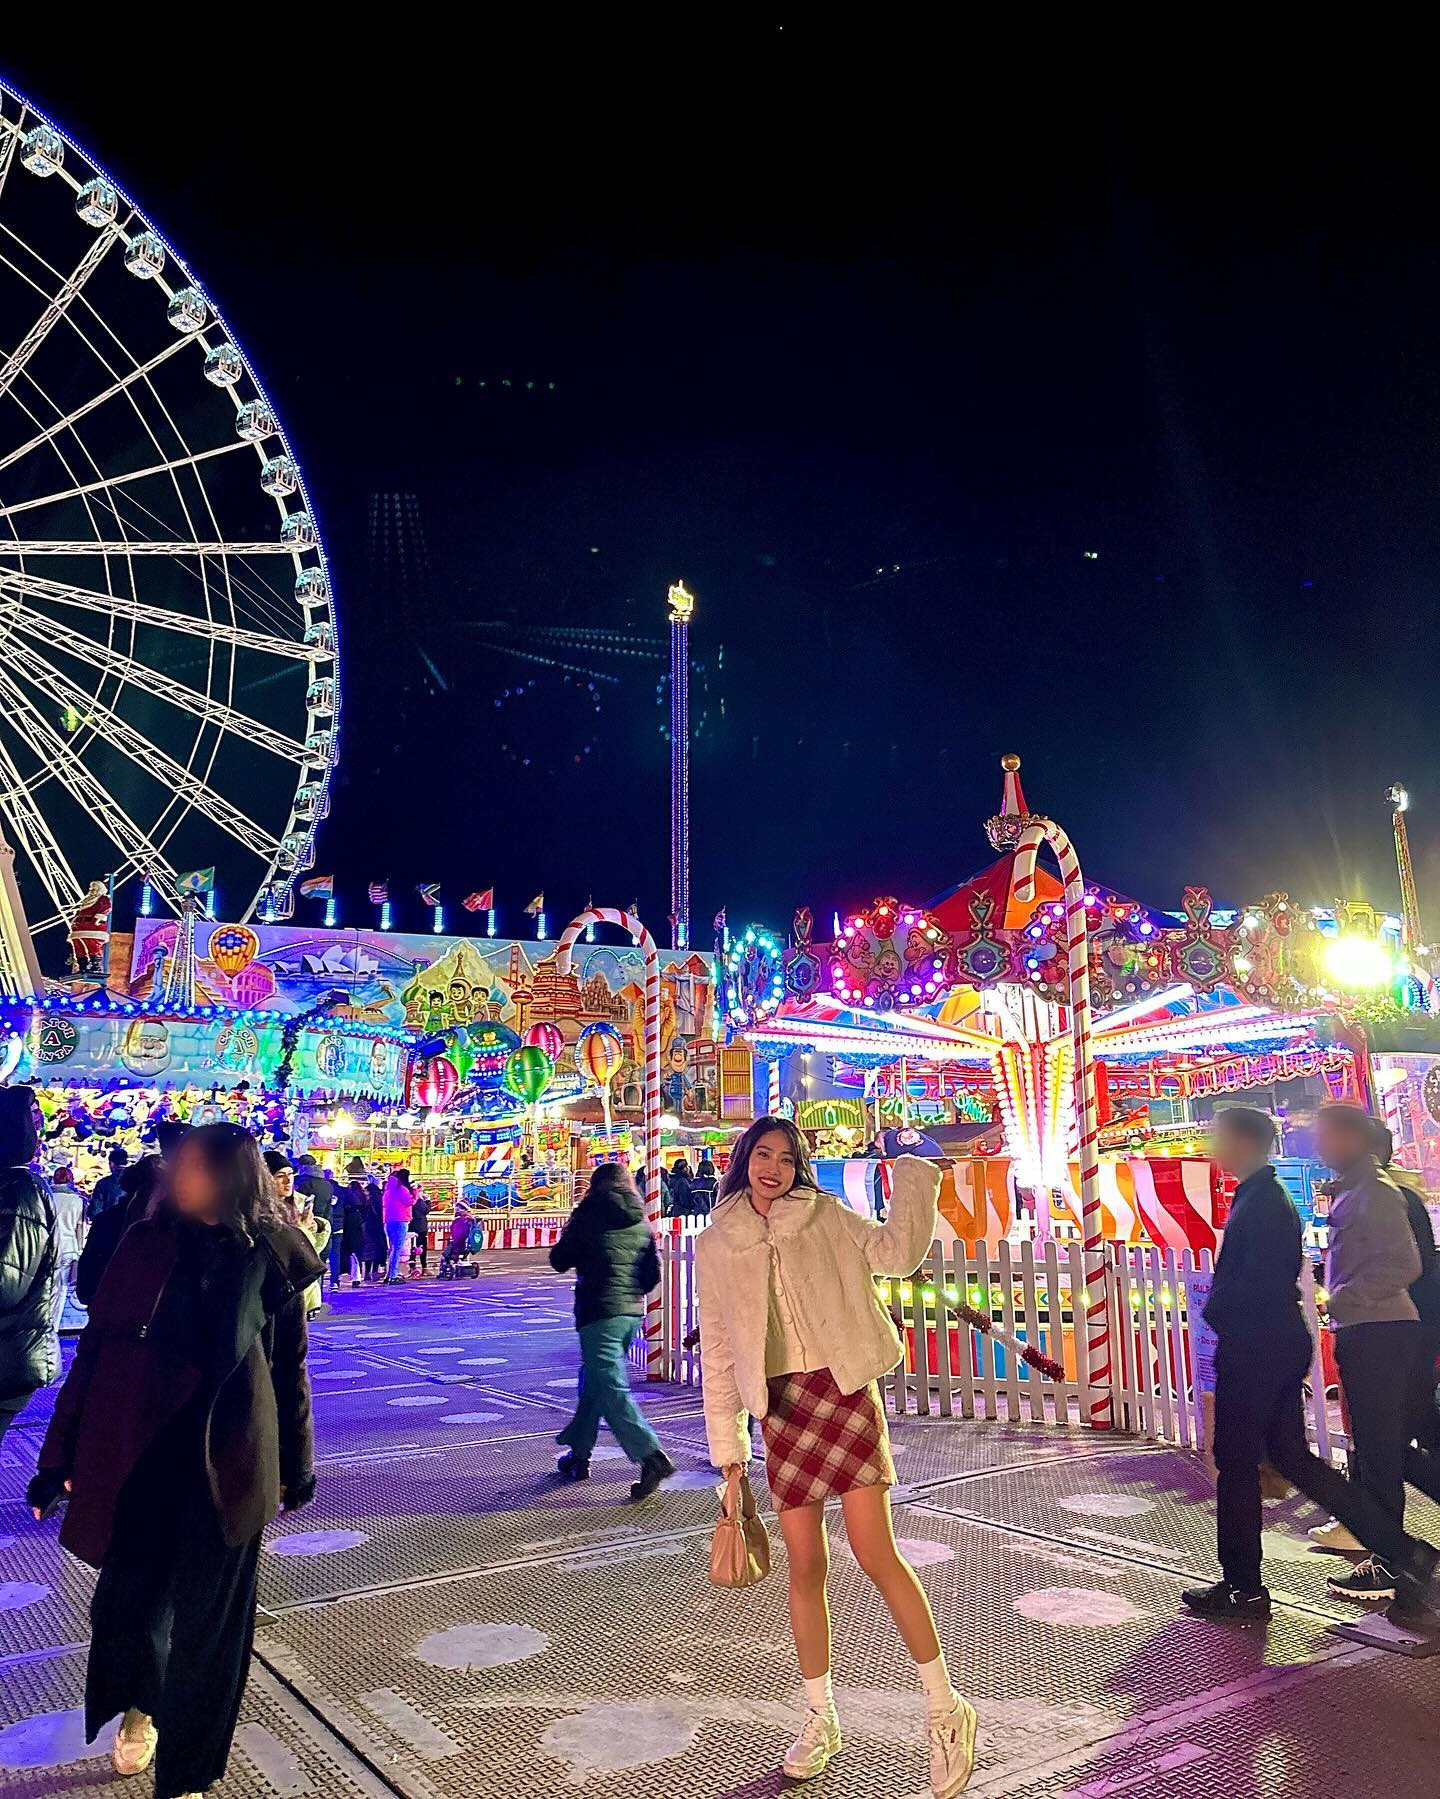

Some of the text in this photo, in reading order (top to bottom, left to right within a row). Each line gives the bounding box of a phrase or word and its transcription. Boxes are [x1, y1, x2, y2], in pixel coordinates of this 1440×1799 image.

[42, 1031, 61, 1045] A
[219, 1029, 254, 1047] CATCH
[28, 1044, 74, 1061] SANTA
